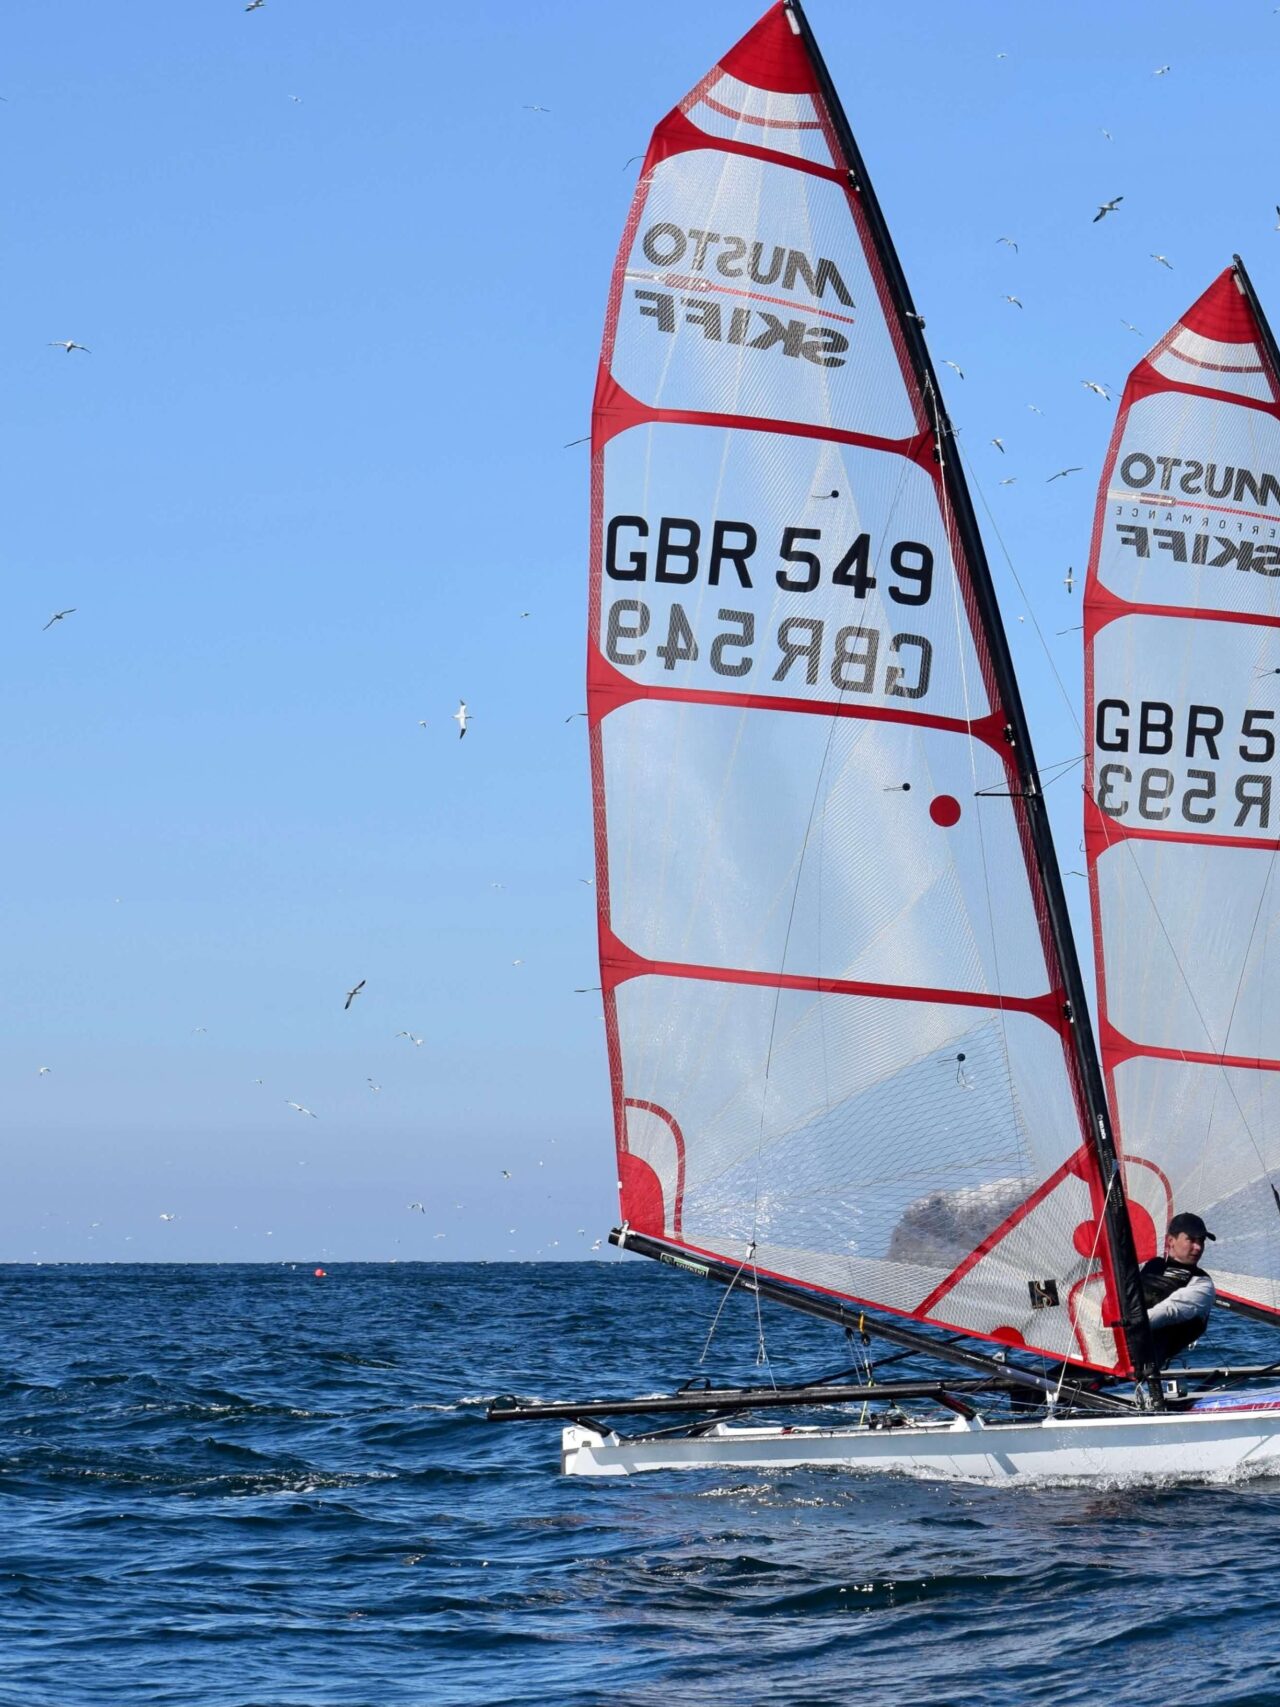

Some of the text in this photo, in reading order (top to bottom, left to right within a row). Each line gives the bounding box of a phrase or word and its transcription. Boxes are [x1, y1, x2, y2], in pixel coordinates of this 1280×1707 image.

[605, 515, 934, 606] GBR 549
[1096, 698, 1224, 760] GBR
